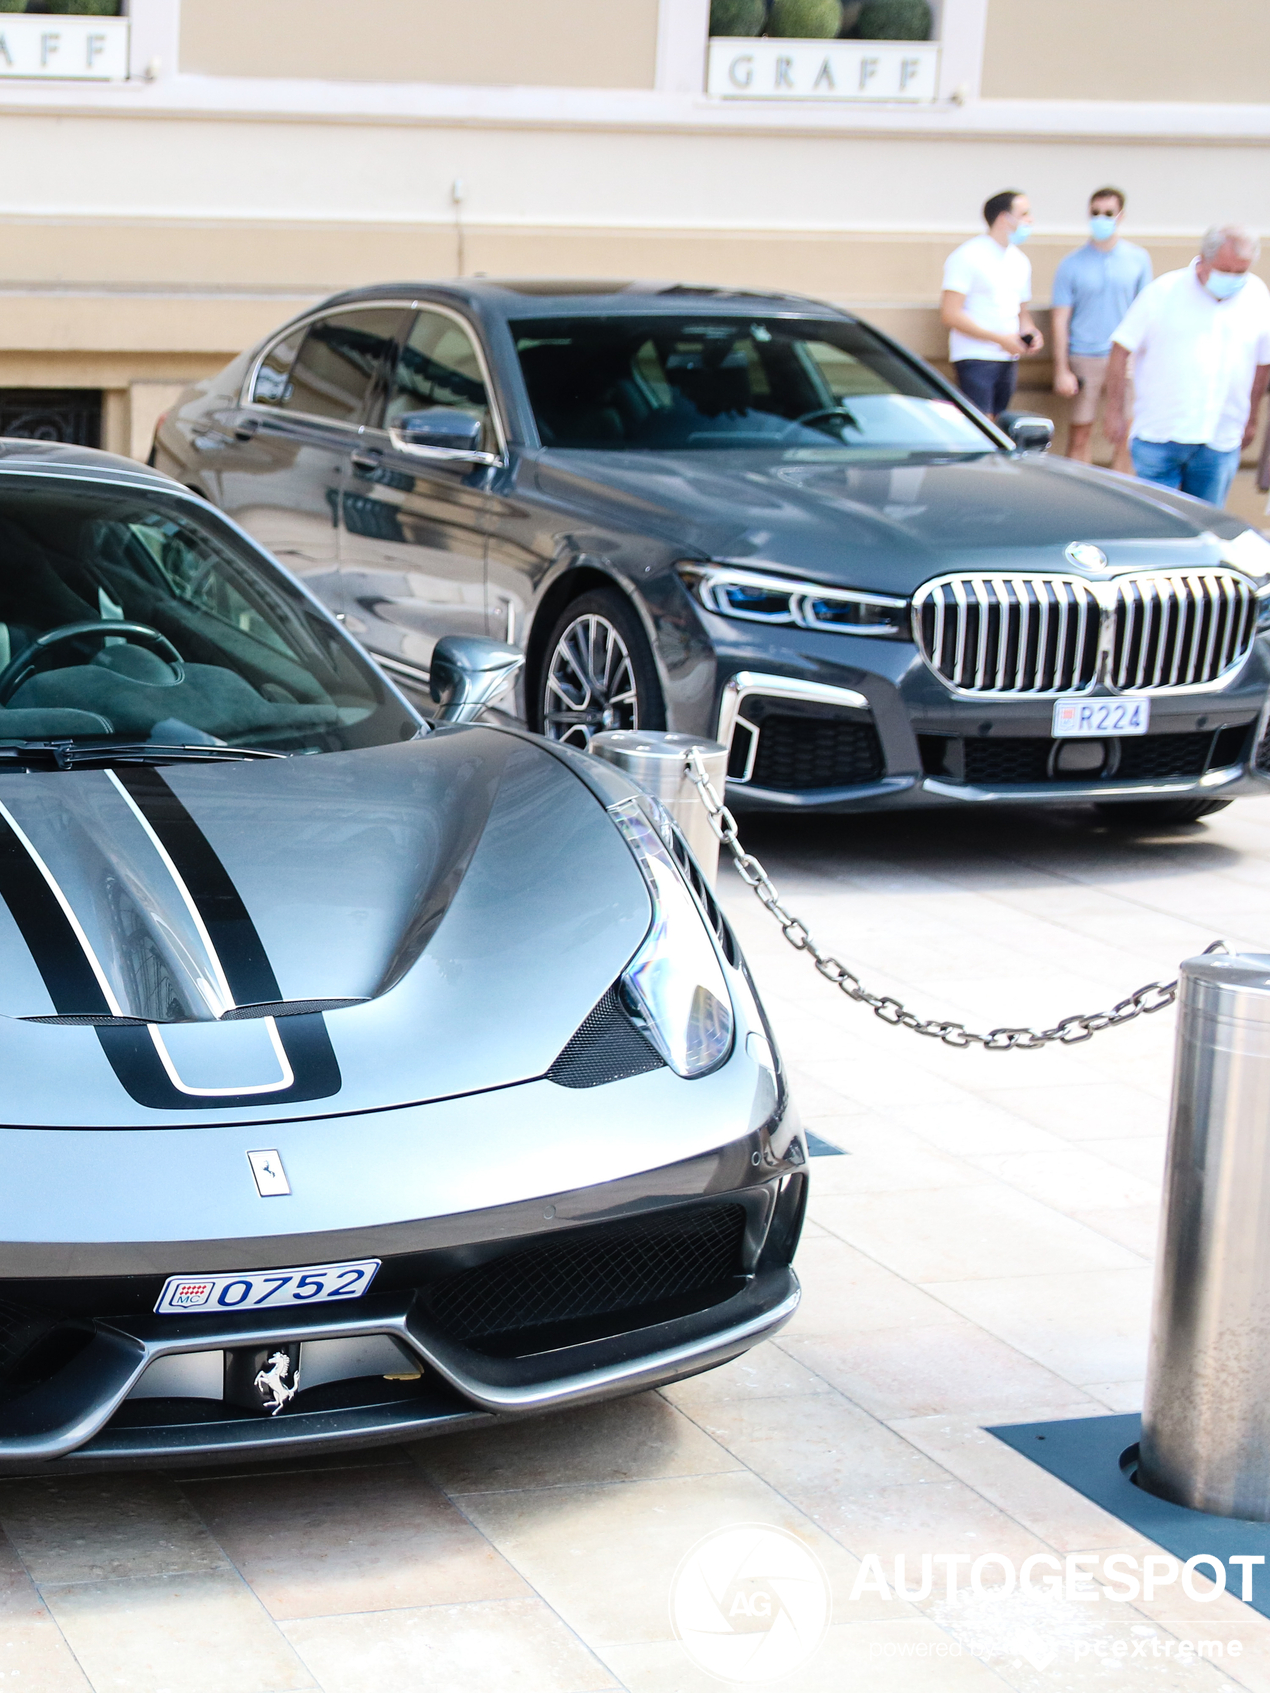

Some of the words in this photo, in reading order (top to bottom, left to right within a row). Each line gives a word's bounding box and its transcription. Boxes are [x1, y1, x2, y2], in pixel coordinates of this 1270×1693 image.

[729, 54, 922, 91] GRAFF
[1079, 704, 1141, 731] R224
[176, 1295, 202, 1304] MC
[217, 1269, 365, 1306] 0752
